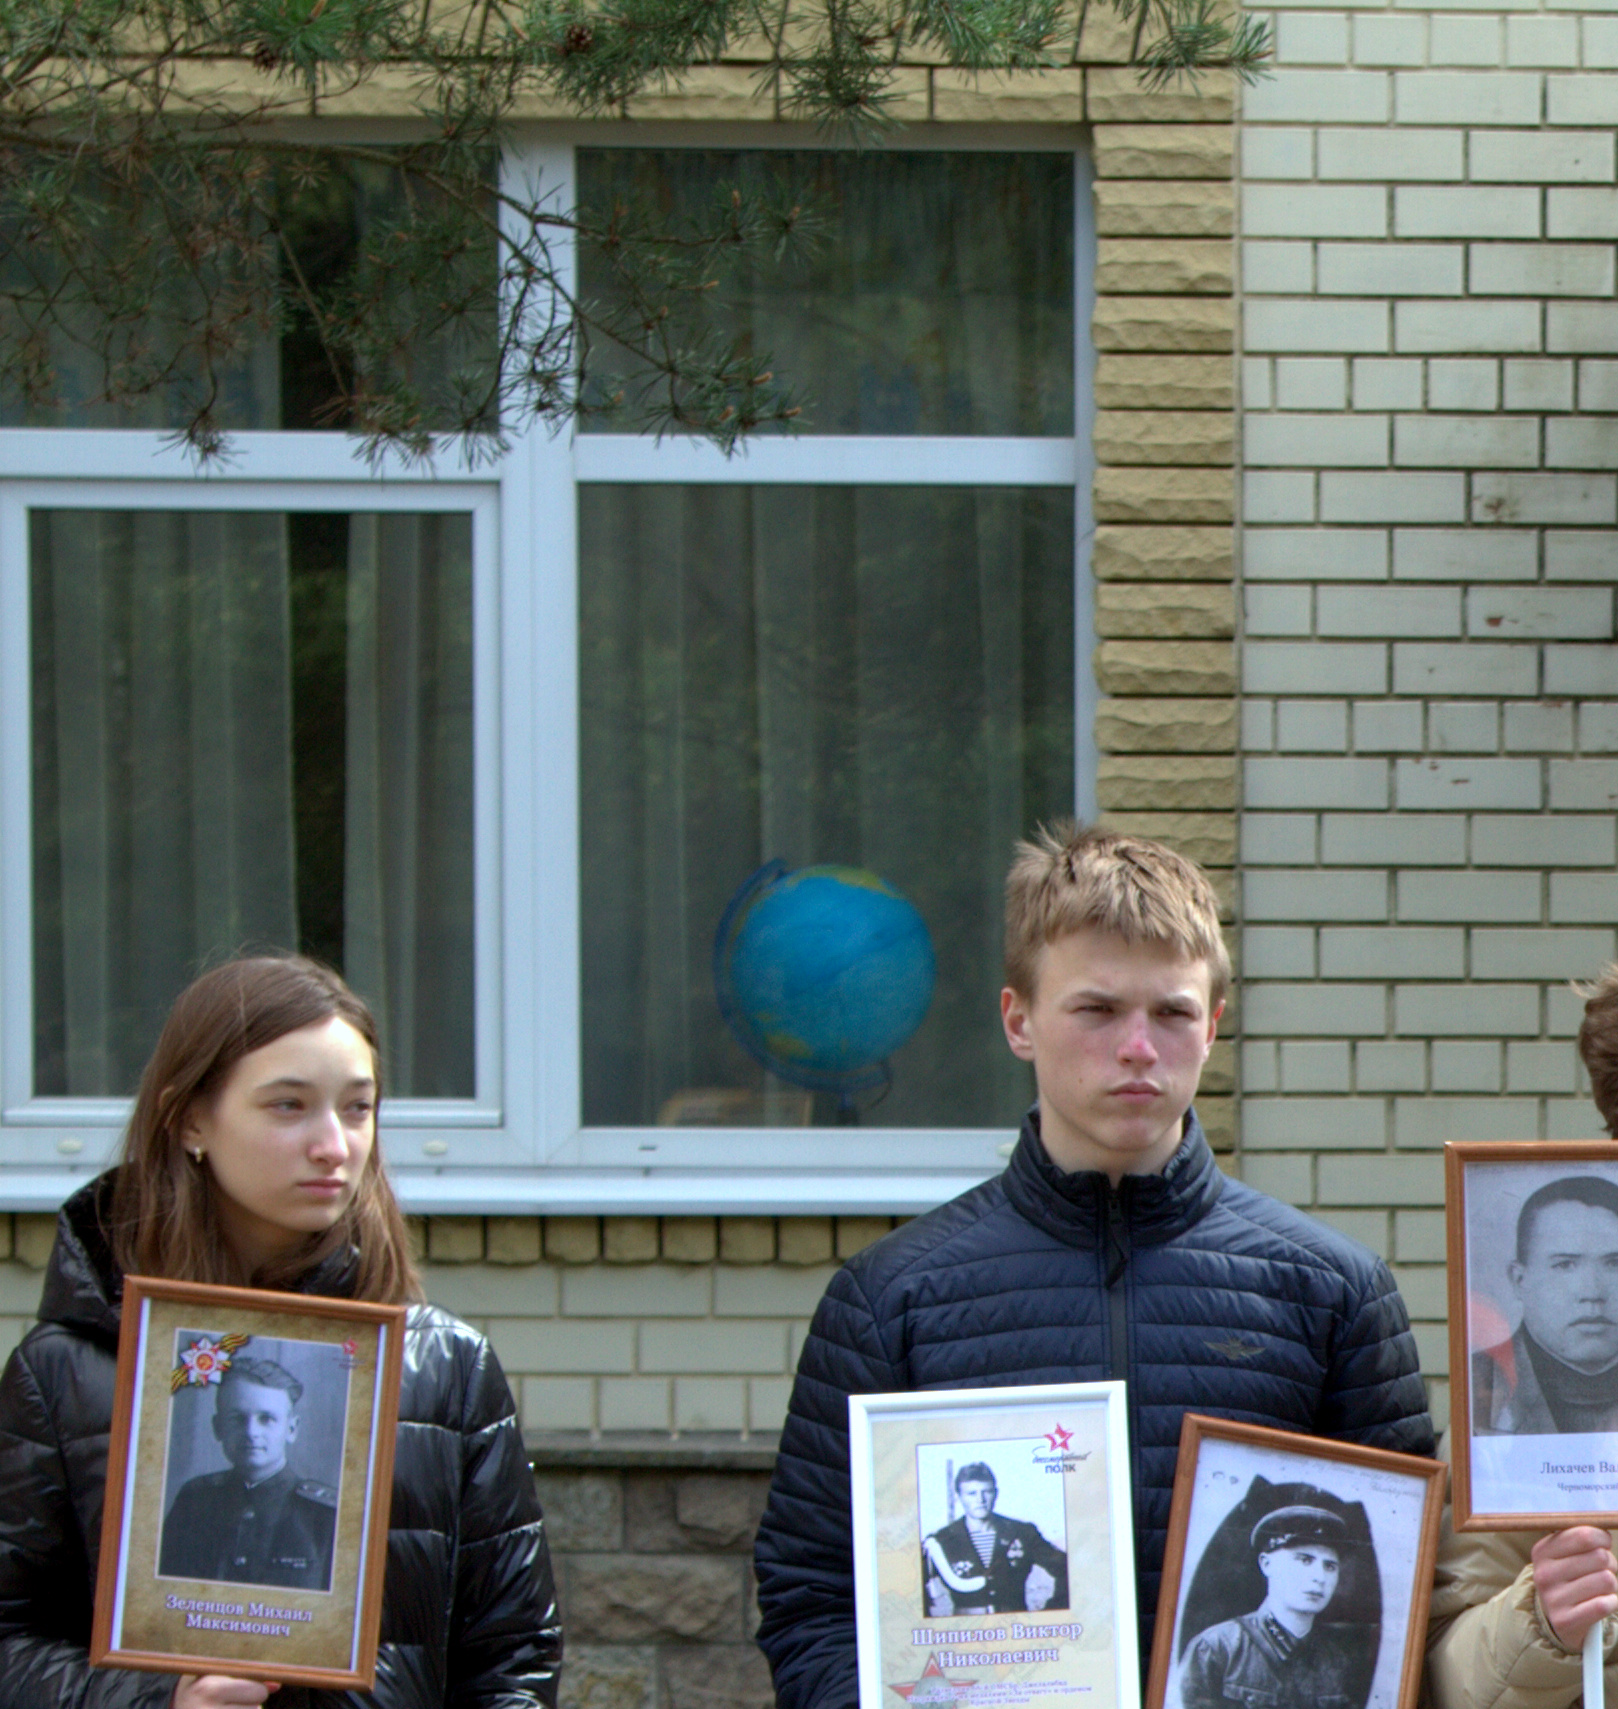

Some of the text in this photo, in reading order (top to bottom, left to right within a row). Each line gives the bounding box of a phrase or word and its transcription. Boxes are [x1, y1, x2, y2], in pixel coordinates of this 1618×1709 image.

[1540, 1462, 1596, 1474] Лихачев
[166, 1593, 313, 1622] Зеленцов Михаил
[185, 1612, 291, 1637] Максимович
[911, 1622, 1083, 1646] Шипилов Виктор
[938, 1648, 1060, 1669] Николаевич
